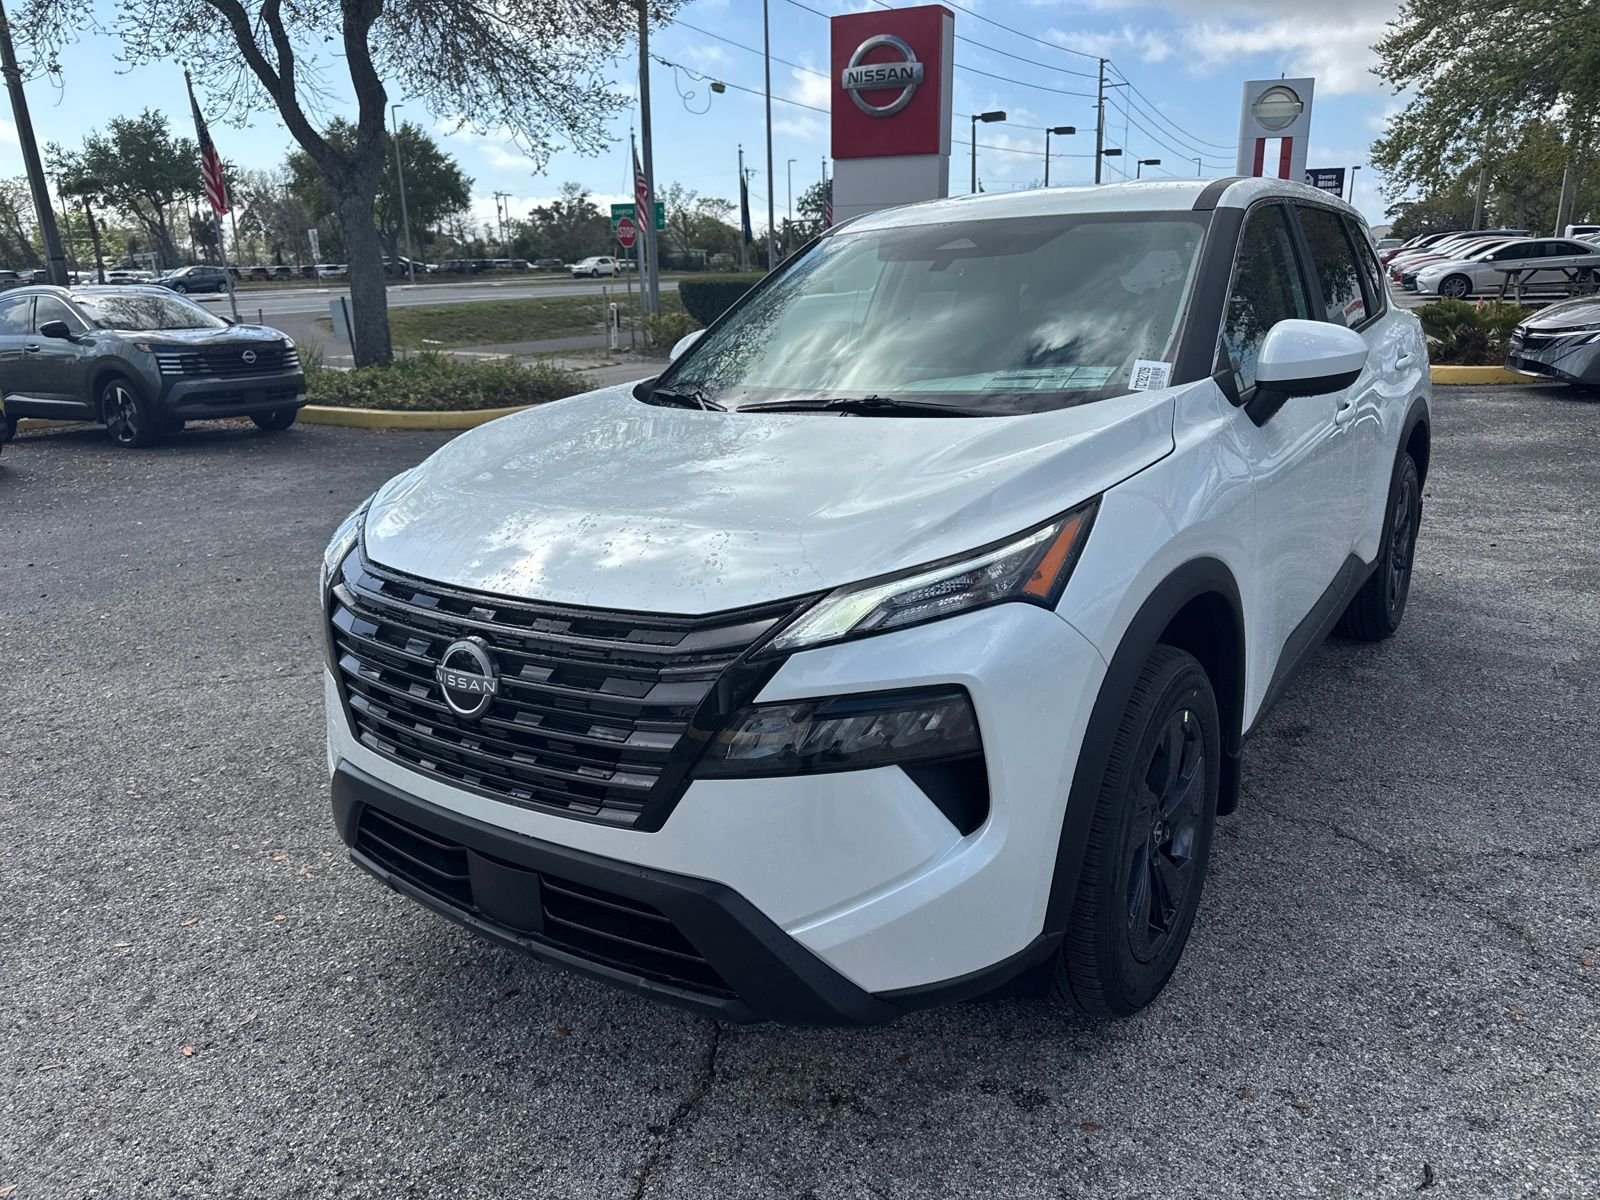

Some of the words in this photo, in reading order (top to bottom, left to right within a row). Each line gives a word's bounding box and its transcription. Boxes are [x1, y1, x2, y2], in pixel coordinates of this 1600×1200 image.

[848, 66, 914, 84] NISSAN
[618, 226, 634, 238] STOP
[436, 669, 495, 692] NISSAN
